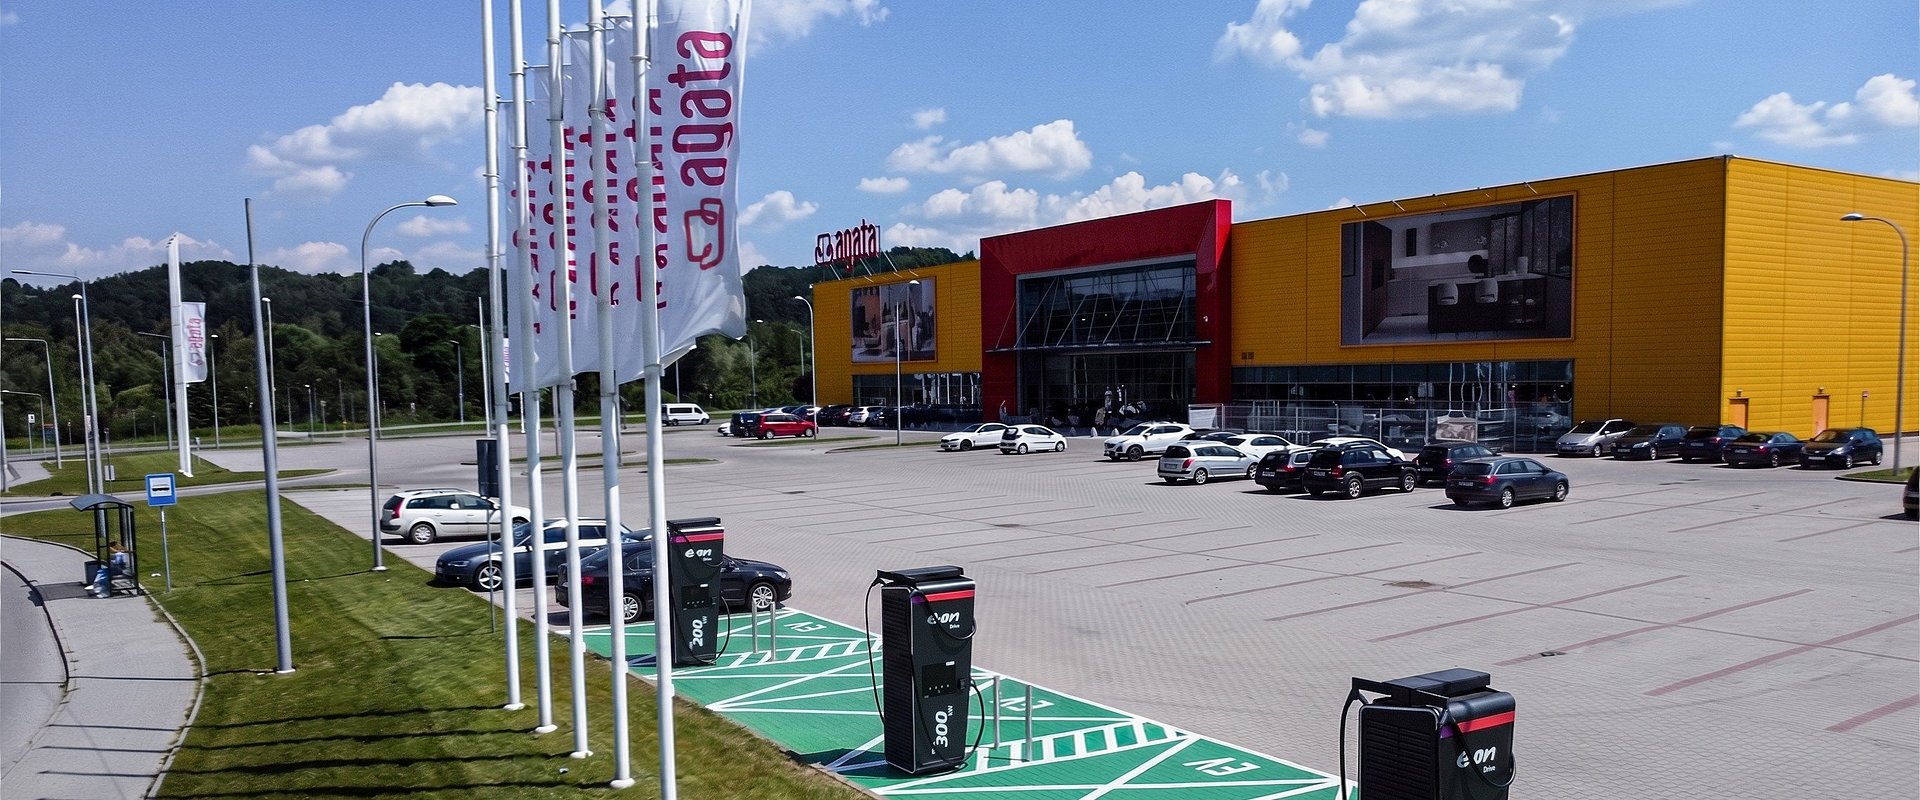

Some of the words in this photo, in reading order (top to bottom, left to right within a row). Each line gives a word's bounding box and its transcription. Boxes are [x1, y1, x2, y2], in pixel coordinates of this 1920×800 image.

[667, 30, 734, 187] agata
[835, 218, 877, 272] agata
[692, 619, 703, 647] 200
[935, 711, 949, 748] 300
[1181, 757, 1261, 776] EV
[1483, 765, 1496, 774] Drive
